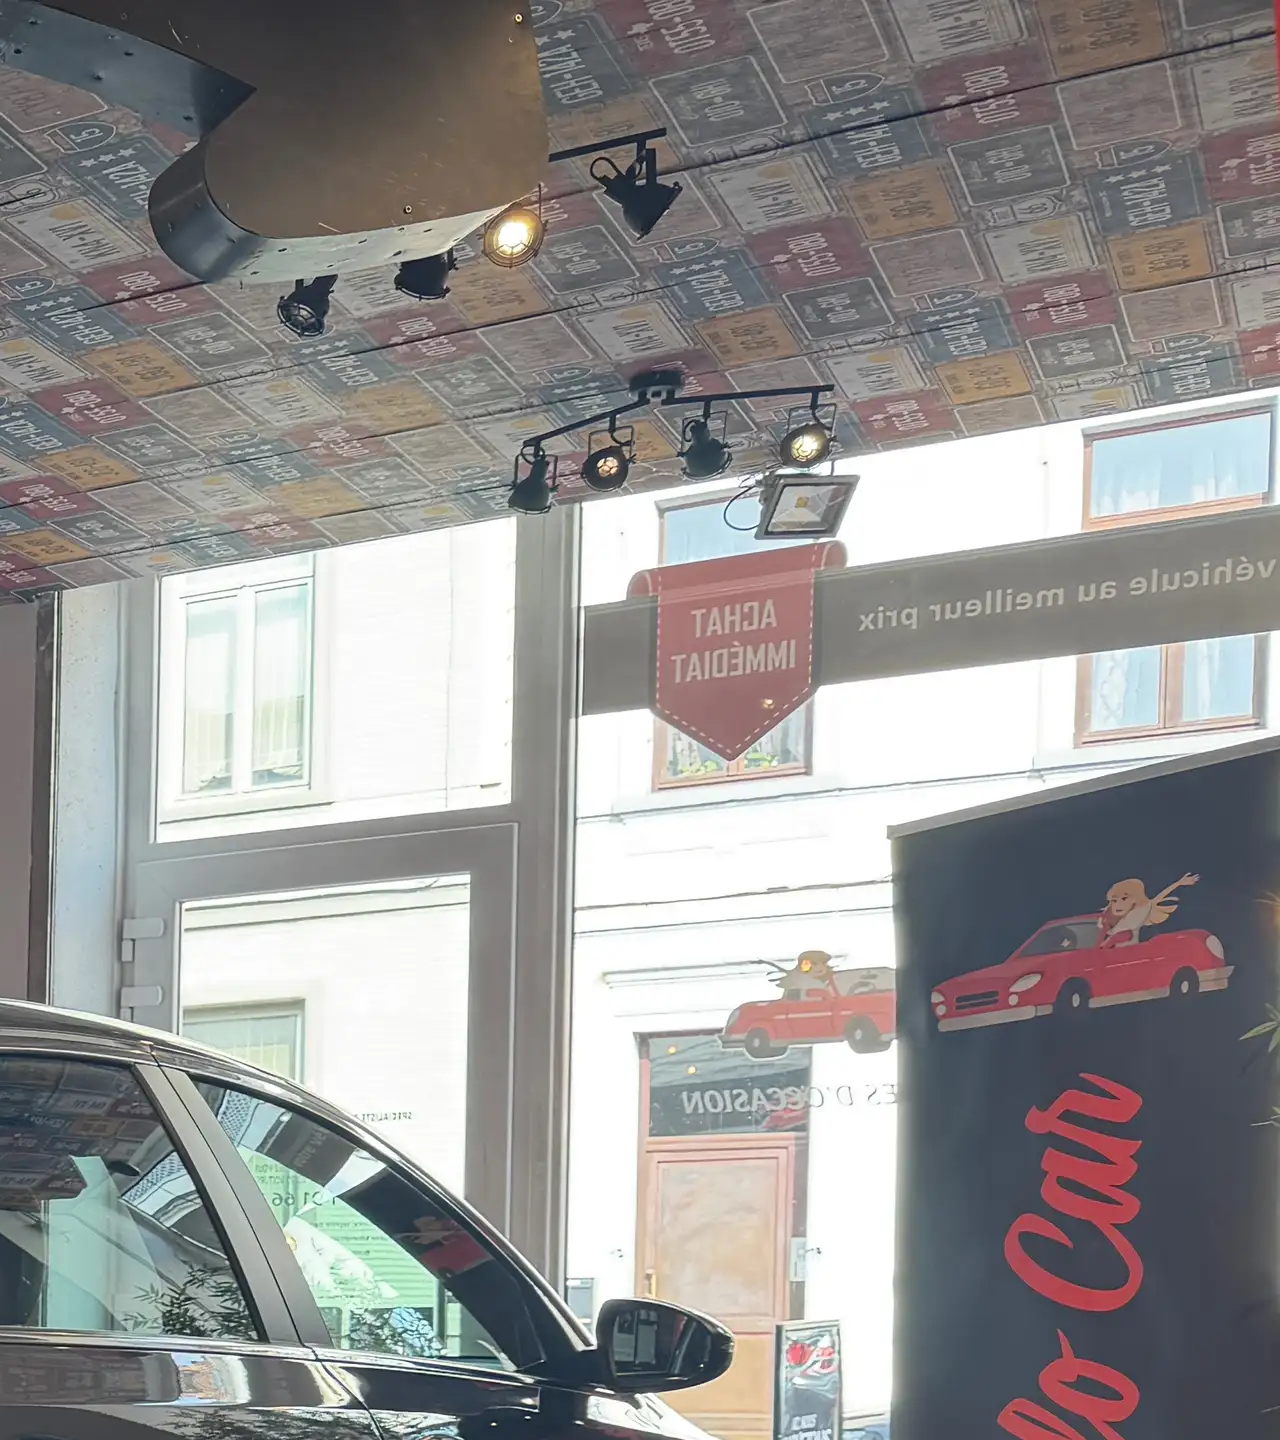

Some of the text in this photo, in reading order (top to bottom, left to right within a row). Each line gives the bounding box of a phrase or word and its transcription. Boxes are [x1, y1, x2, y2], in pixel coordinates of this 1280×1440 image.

[69, 127, 103, 142] 15
[45, 305, 113, 345] GEH-142A
[0, 418, 62, 451] GEH-142A
[1003, 1072, 1145, 1313] Car
